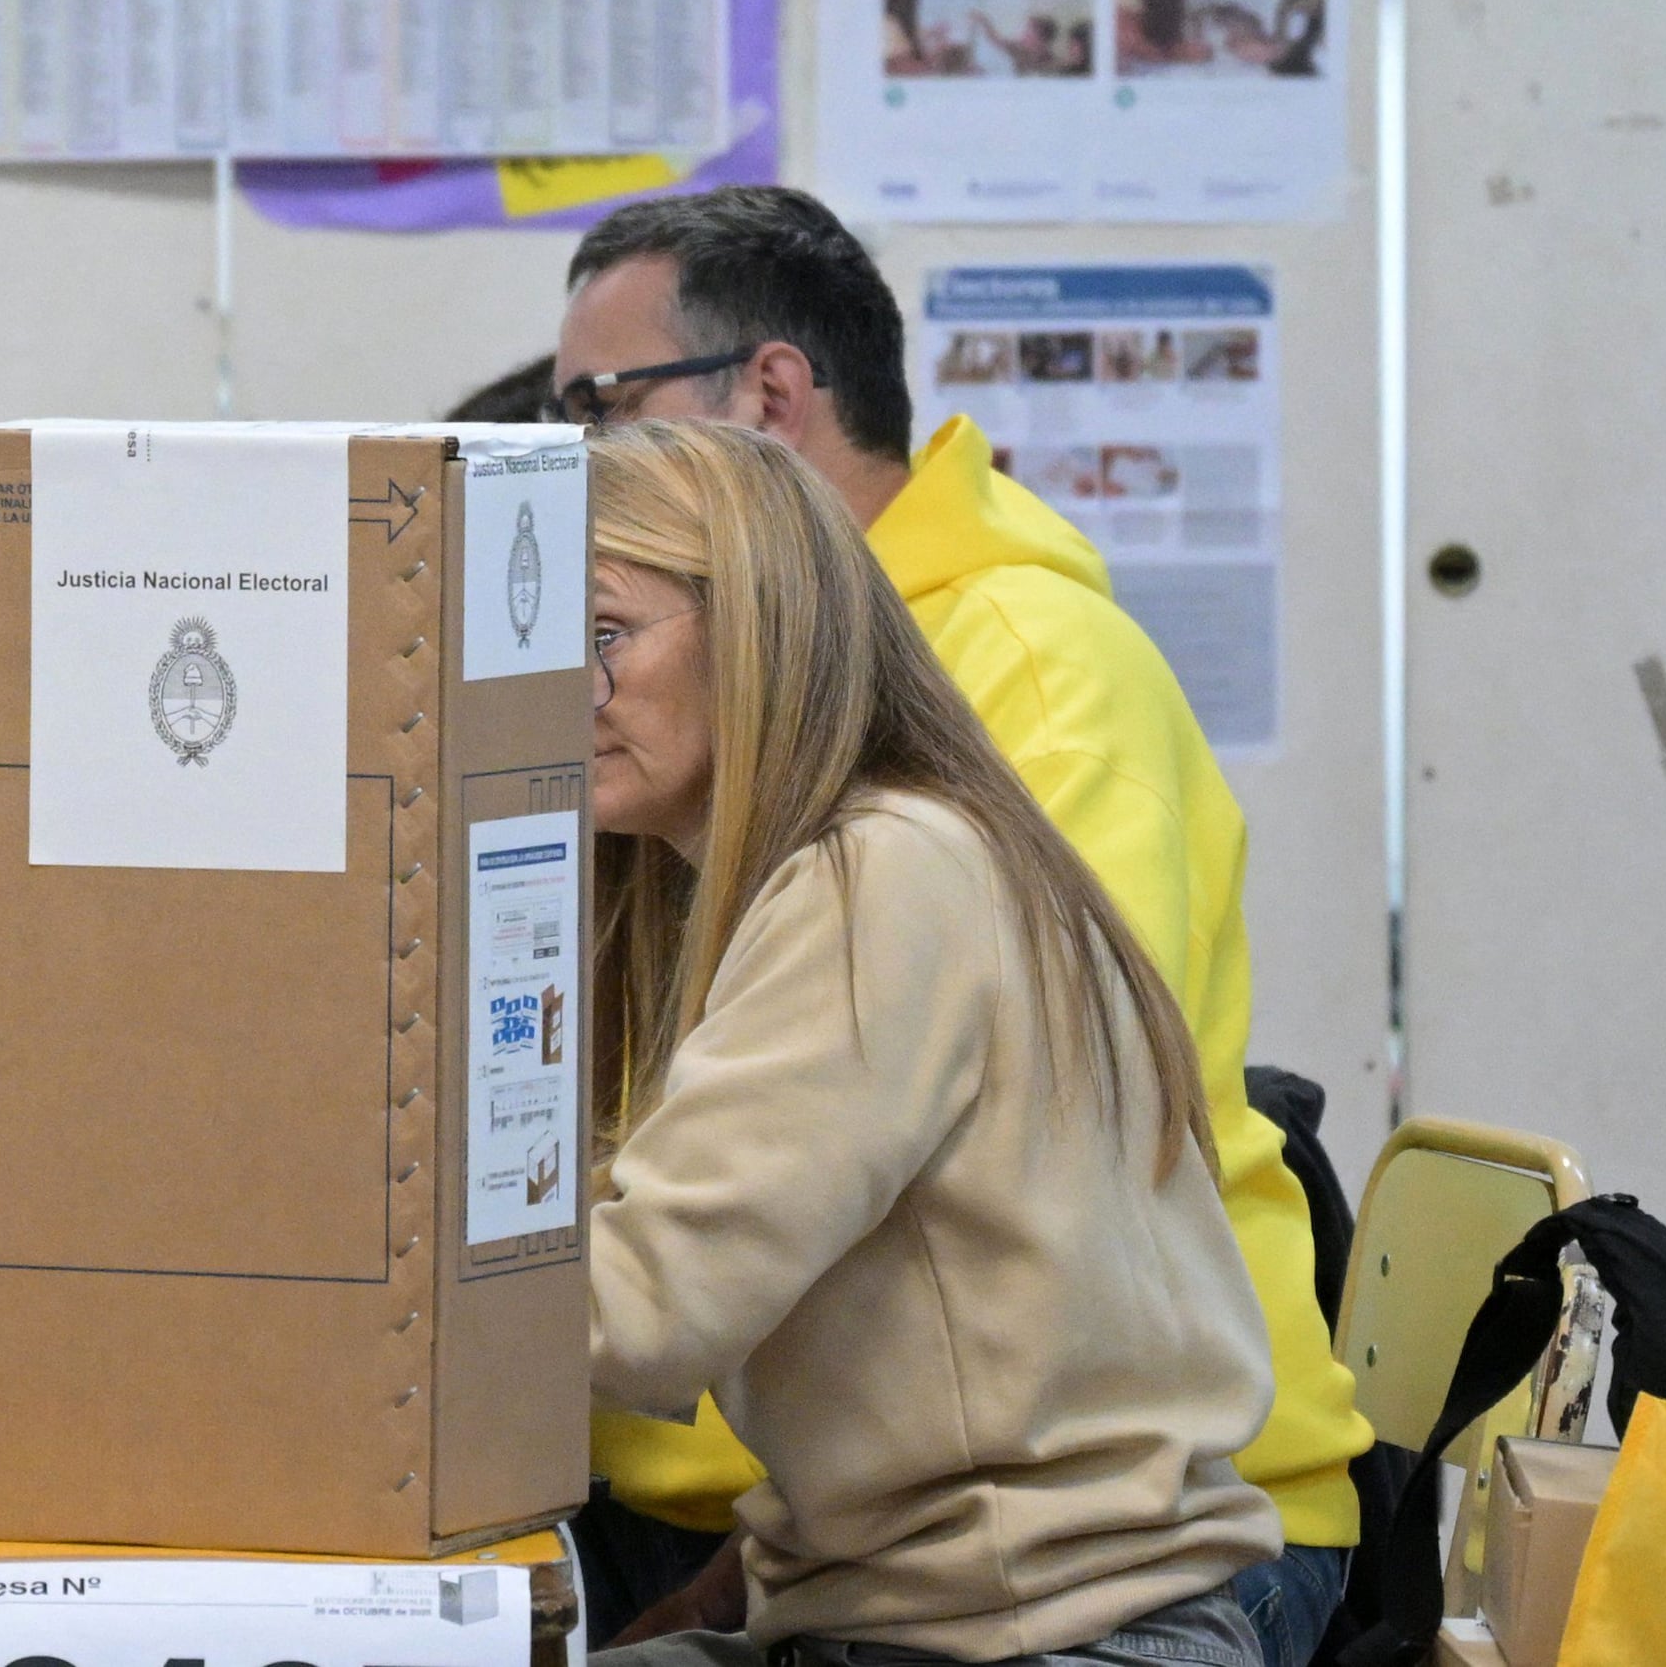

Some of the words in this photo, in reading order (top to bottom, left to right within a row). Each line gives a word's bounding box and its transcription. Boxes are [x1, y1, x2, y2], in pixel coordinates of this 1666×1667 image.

[127, 428, 137, 458] esa
[505, 456, 540, 475] Nacional
[541, 451, 579, 472] Electoral
[3, 512, 19, 523] LA
[57, 570, 136, 589] Justicia
[143, 571, 231, 591] Nacional
[238, 573, 329, 592] Electoral
[62, 1576, 101, 1596] Nº
[342, 1607, 392, 1616] OCTUBRE
